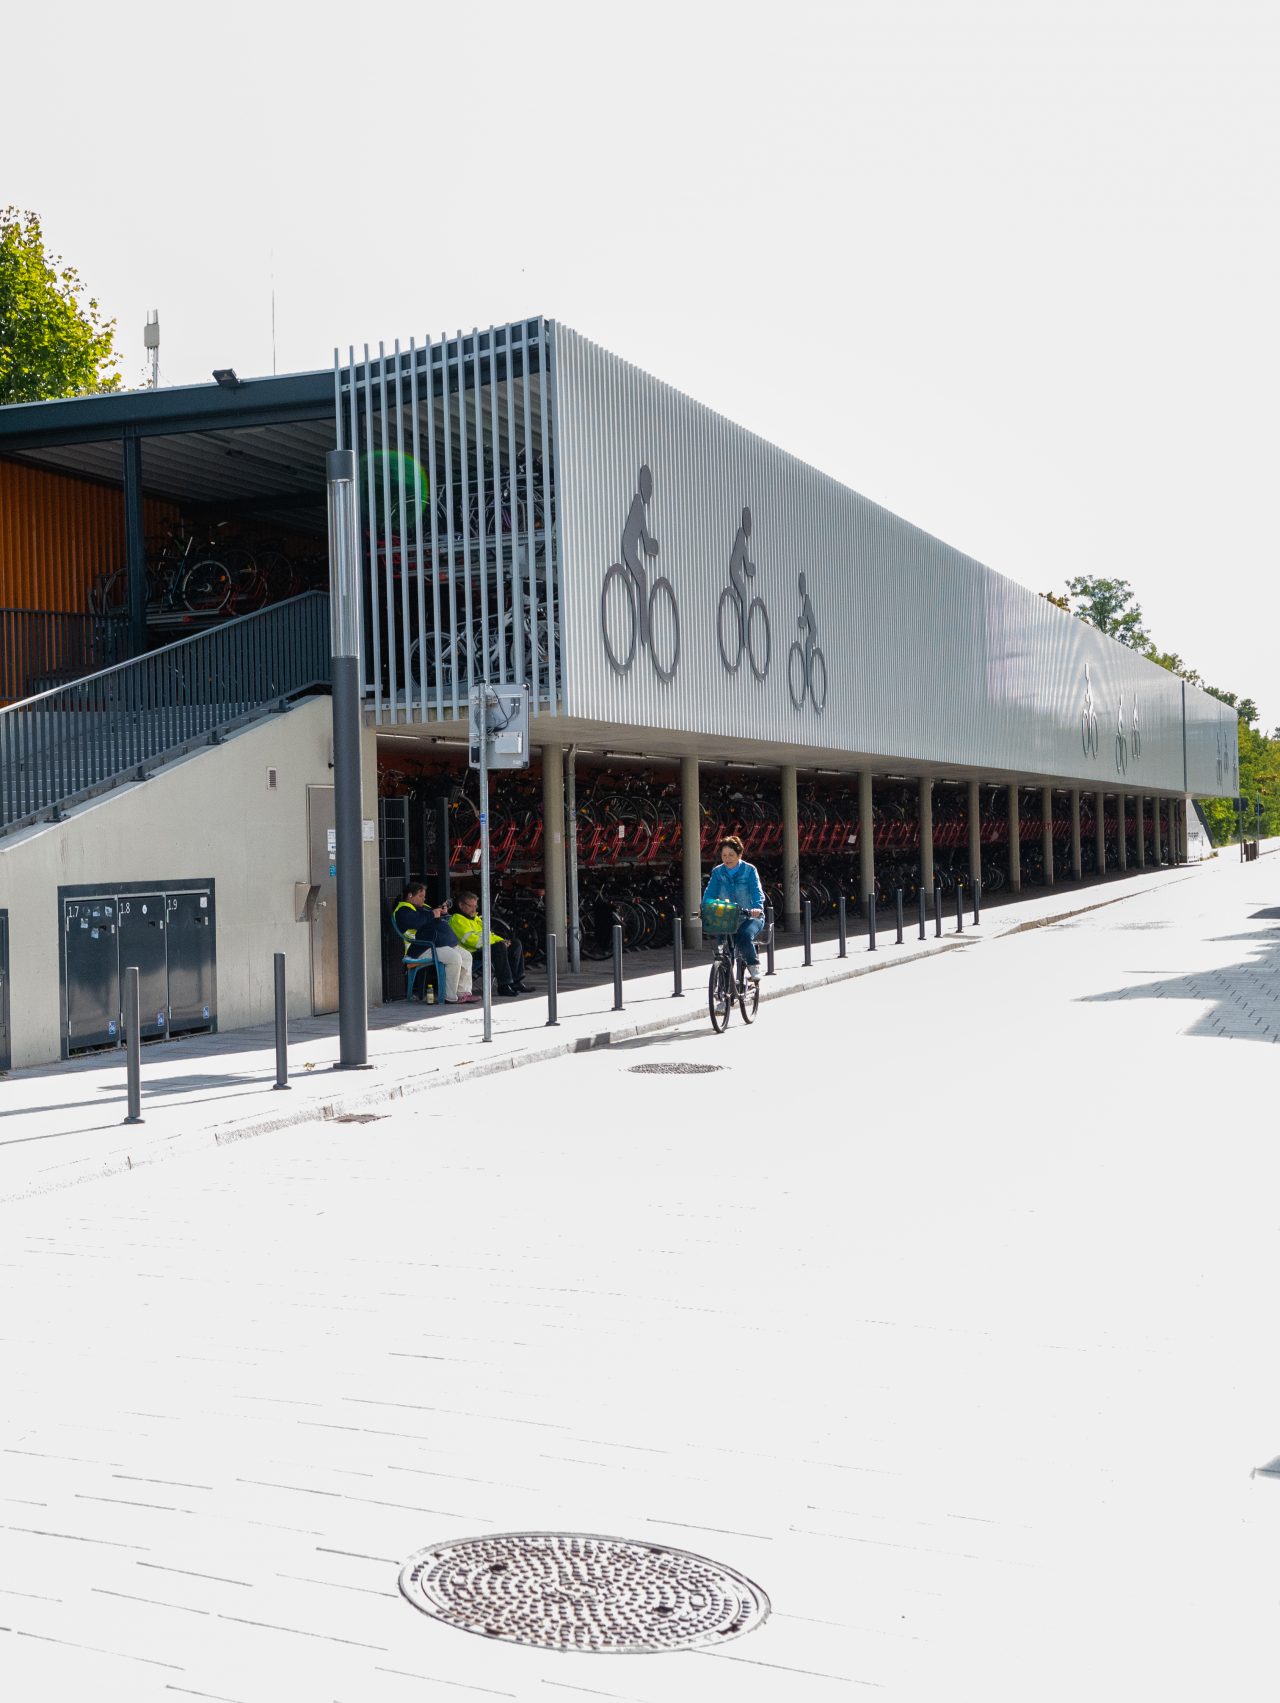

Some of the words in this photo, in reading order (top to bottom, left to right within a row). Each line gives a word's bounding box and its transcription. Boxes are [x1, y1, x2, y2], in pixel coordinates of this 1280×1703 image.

[120, 902, 131, 914] 1.8
[167, 899, 178, 911] 1.9
[68, 905, 79, 918] 1.7
